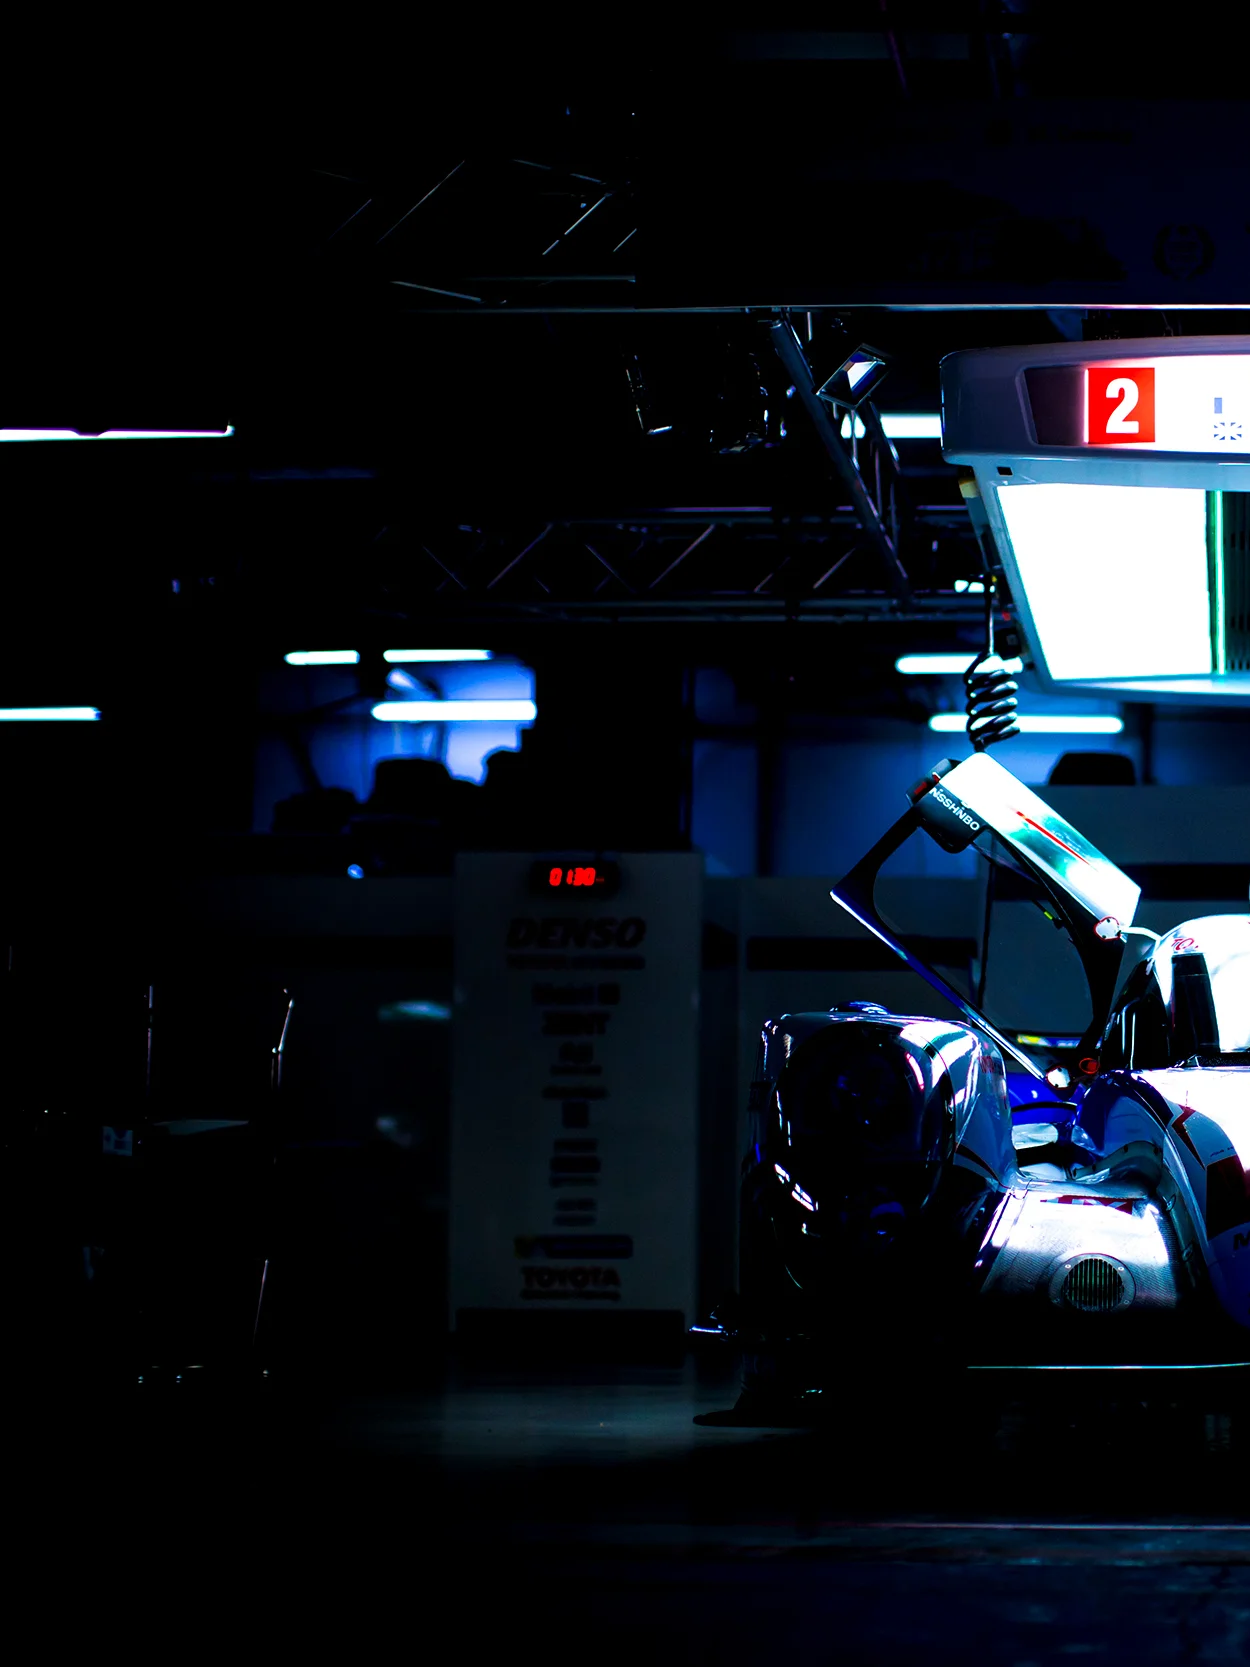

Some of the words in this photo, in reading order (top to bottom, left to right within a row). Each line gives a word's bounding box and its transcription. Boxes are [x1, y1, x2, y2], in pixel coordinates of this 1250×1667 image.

[1105, 377, 1140, 434] 2
[505, 917, 646, 949] DENSO
[521, 1267, 620, 1288] TOYOTA
